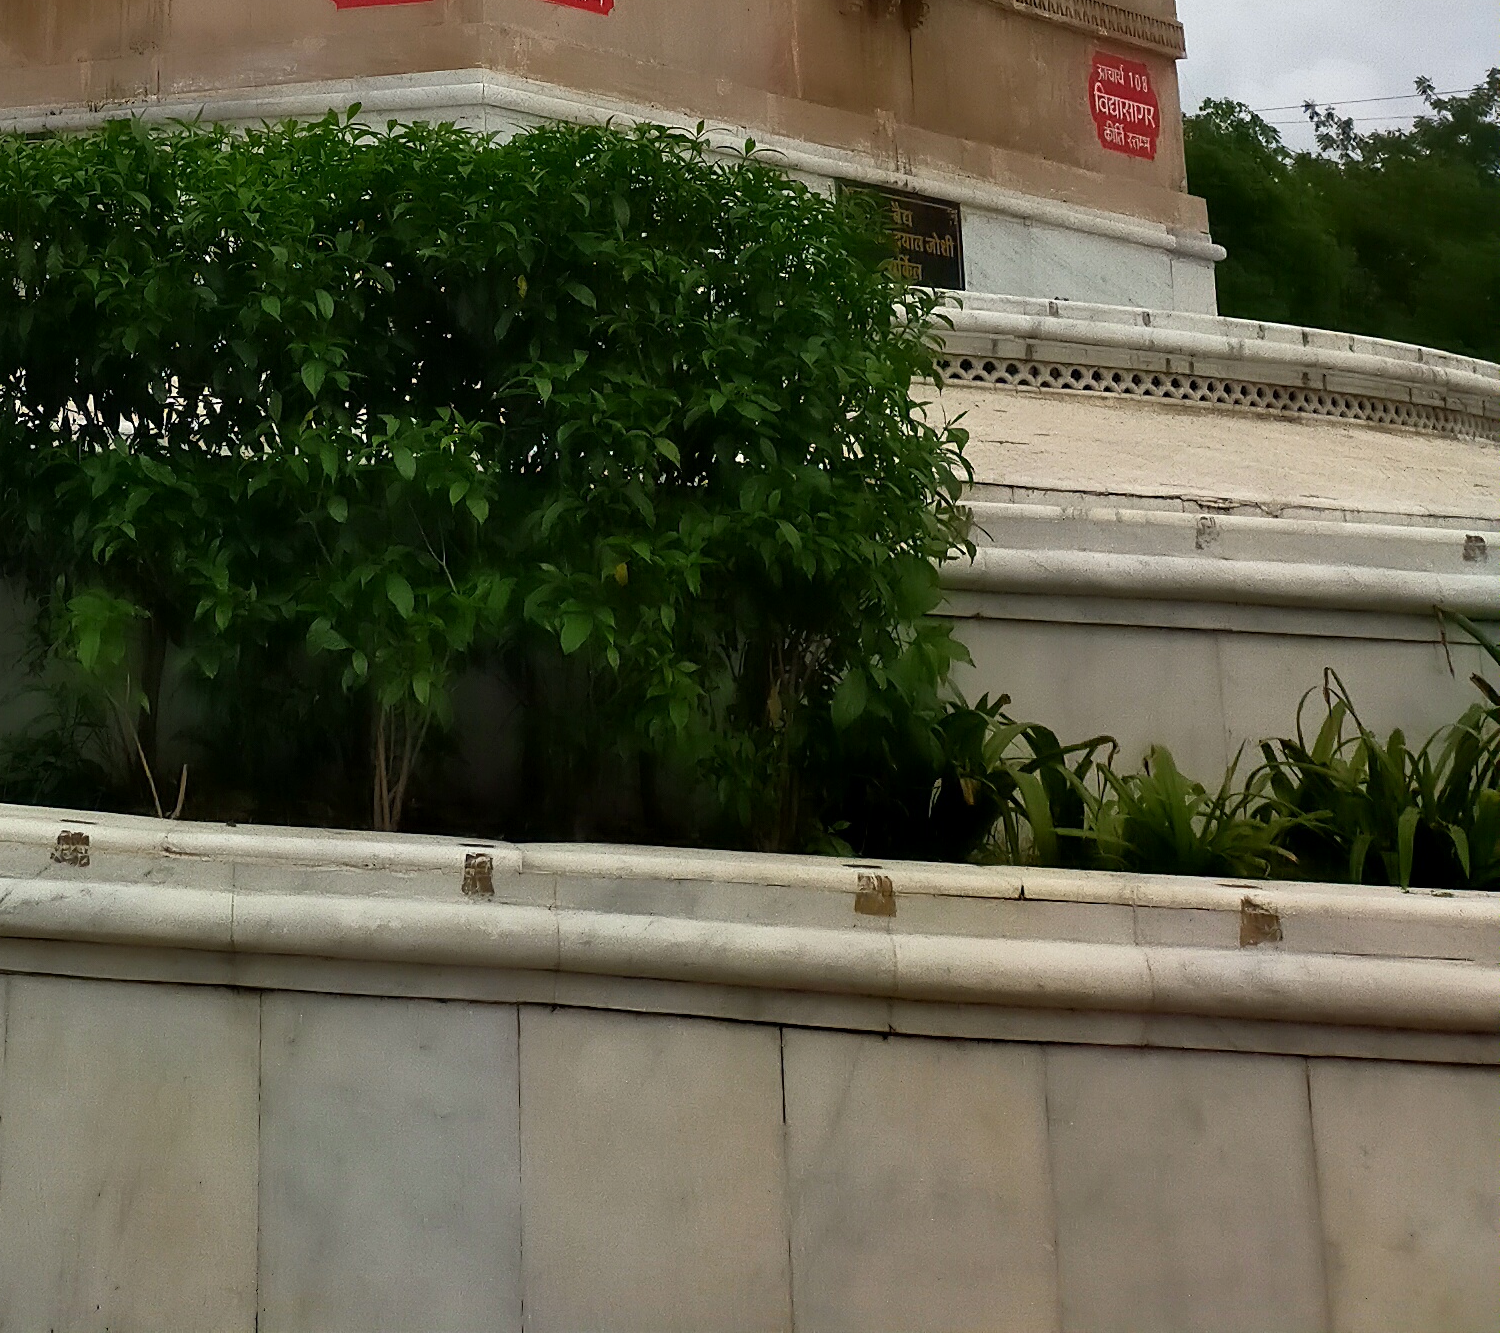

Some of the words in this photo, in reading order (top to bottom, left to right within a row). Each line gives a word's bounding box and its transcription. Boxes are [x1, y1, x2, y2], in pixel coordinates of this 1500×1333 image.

[1128, 72, 1148, 93] 108
[1094, 82, 1156, 128] विद्यासागर
[1104, 120, 1125, 146] कीर्ति
[925, 232, 954, 258] जोशी
